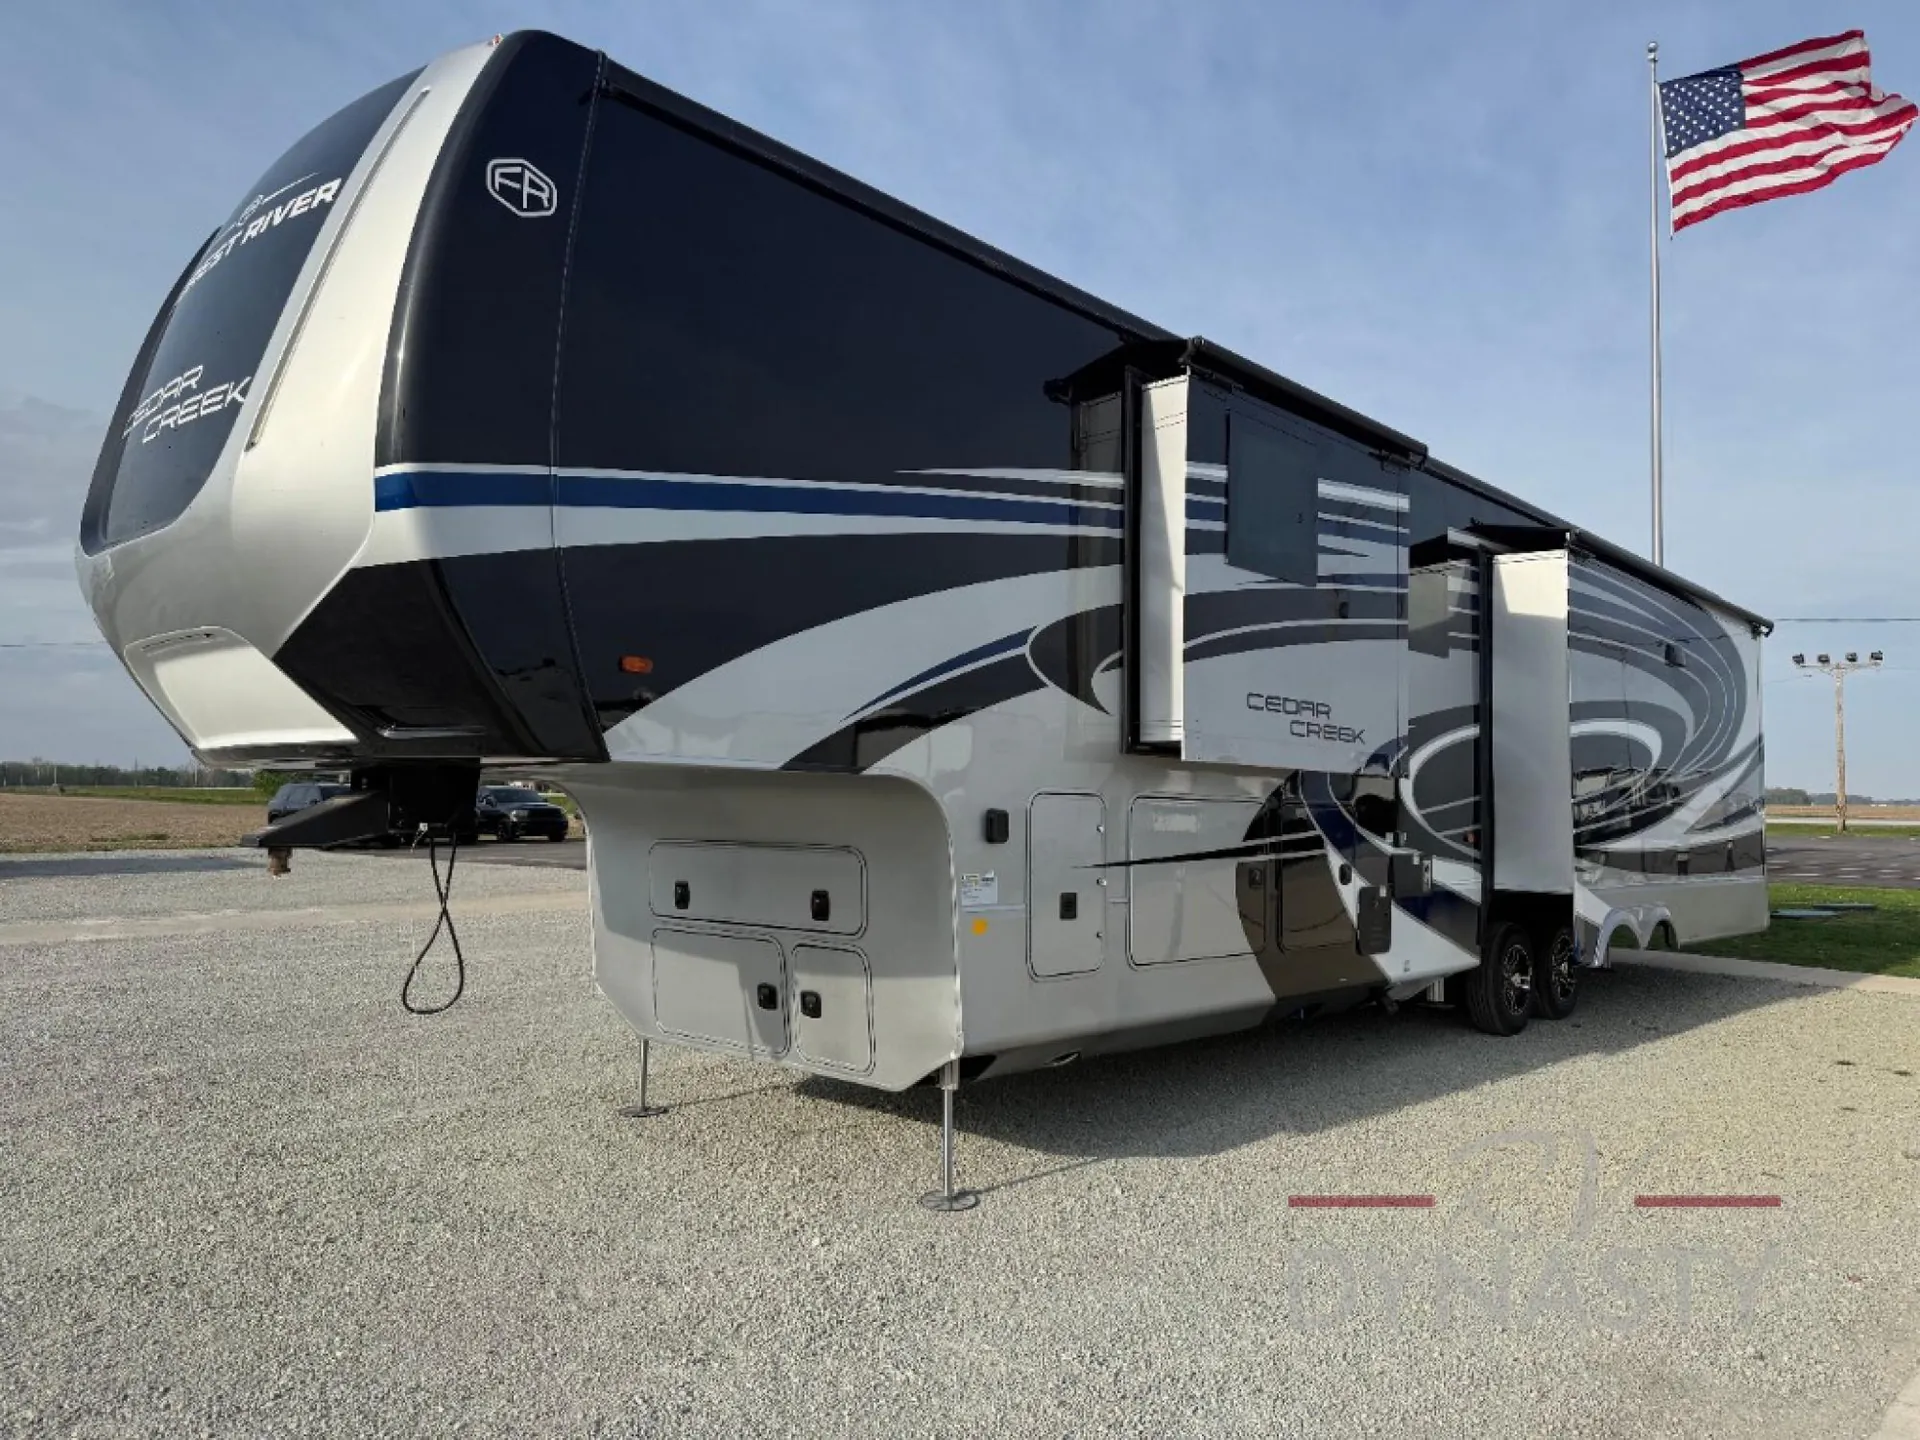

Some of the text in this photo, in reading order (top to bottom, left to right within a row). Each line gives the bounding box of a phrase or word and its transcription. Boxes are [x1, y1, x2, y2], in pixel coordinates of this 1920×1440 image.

[240, 178, 342, 246] RIVER
[142, 376, 252, 444] CREEK
[1246, 691, 1332, 720] CEDAR
[1289, 719, 1366, 745] CREEK
